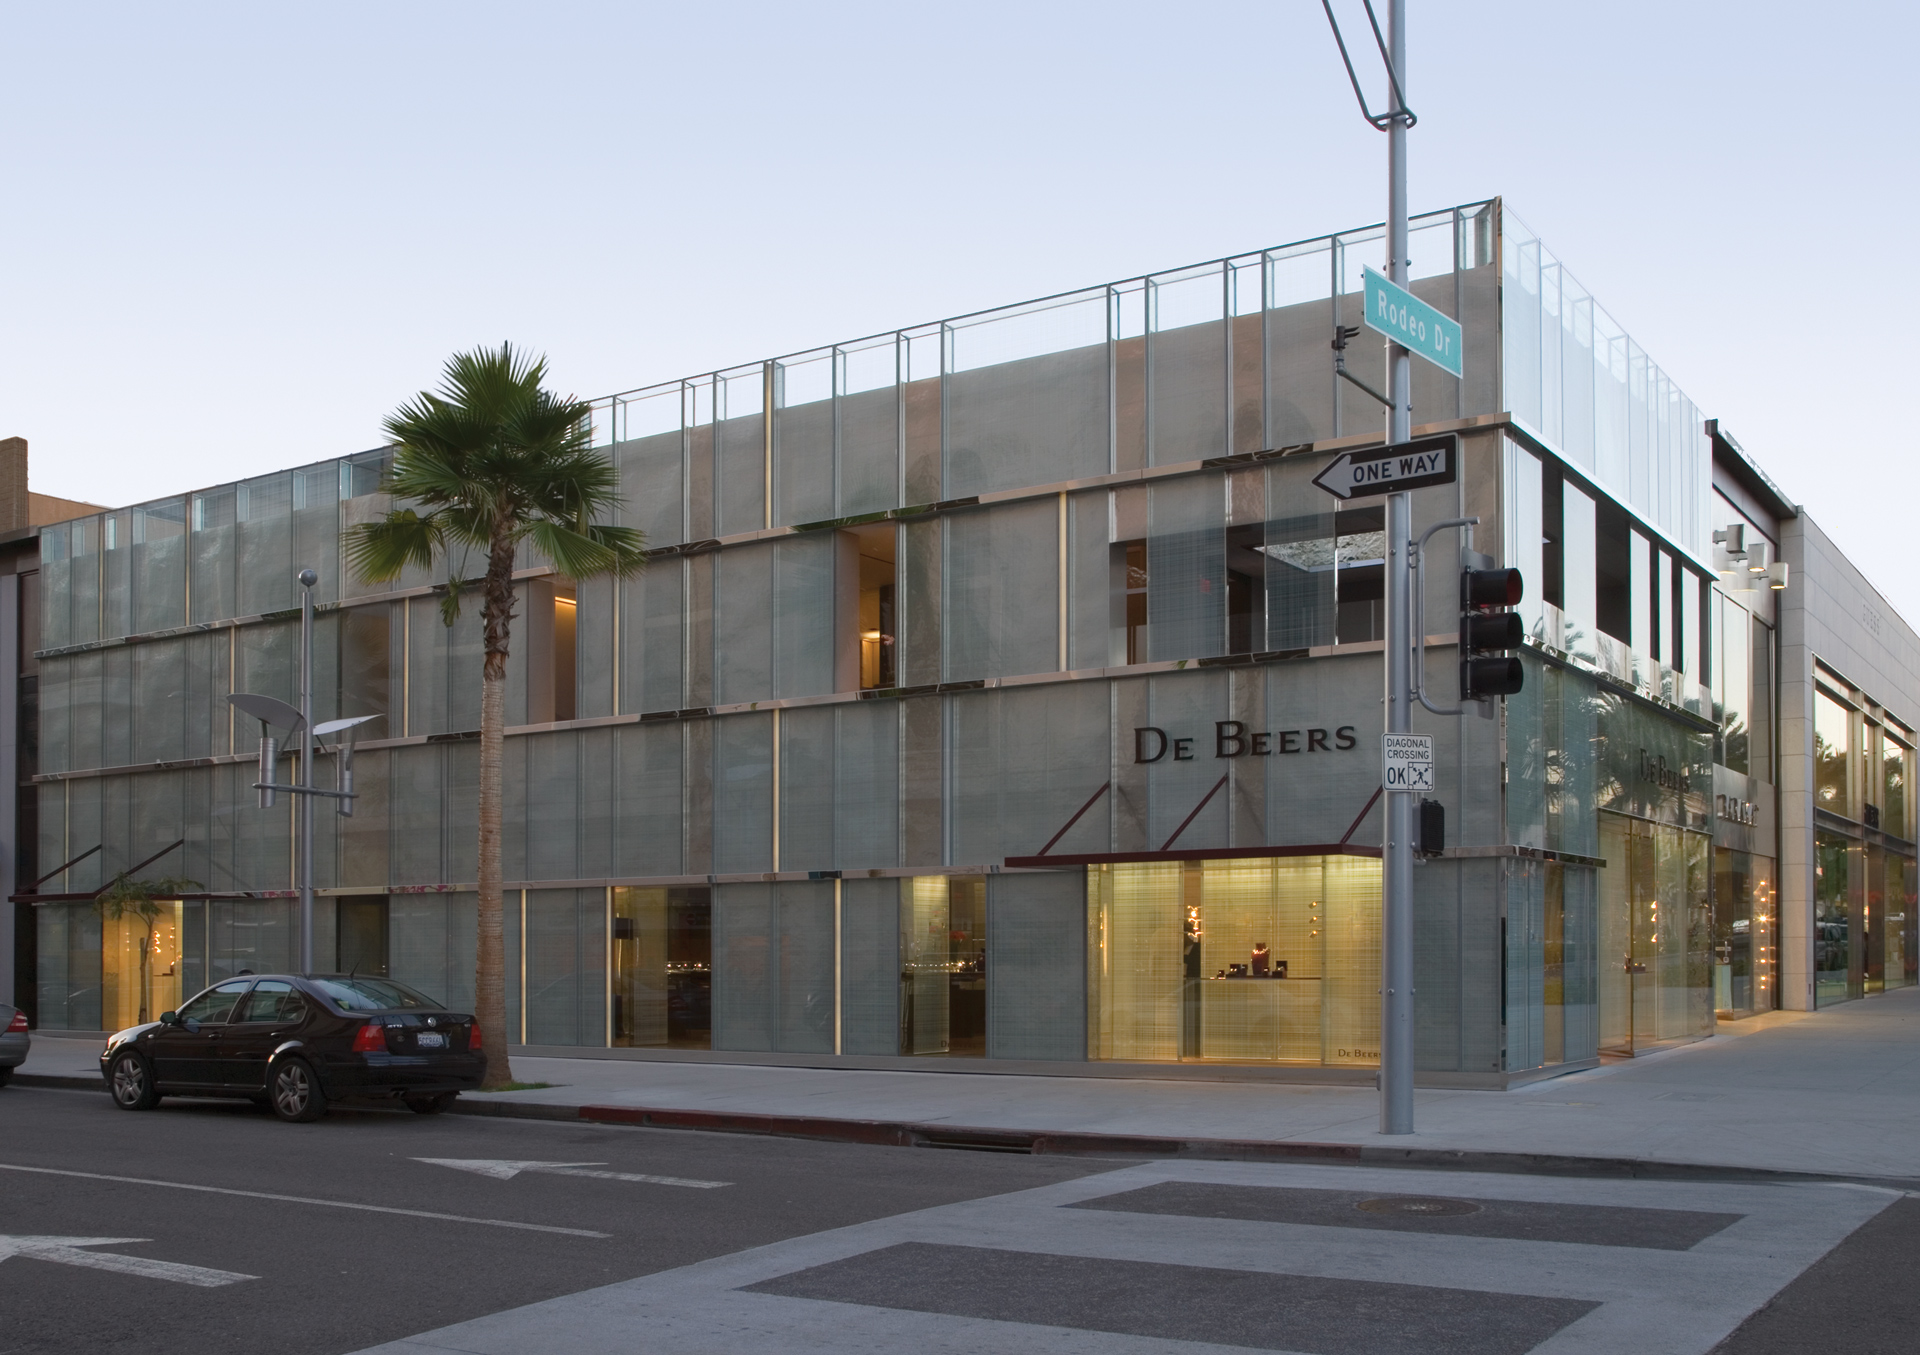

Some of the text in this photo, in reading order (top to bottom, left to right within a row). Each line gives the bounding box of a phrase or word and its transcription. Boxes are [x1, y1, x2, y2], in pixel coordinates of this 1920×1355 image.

[1378, 289, 1450, 356] Rodeo Dr
[1353, 453, 1440, 483] ONE WAY
[1386, 738, 1430, 748] DIAGONAL
[1387, 750, 1430, 760] CROSSING
[1387, 767, 1406, 784] OK
